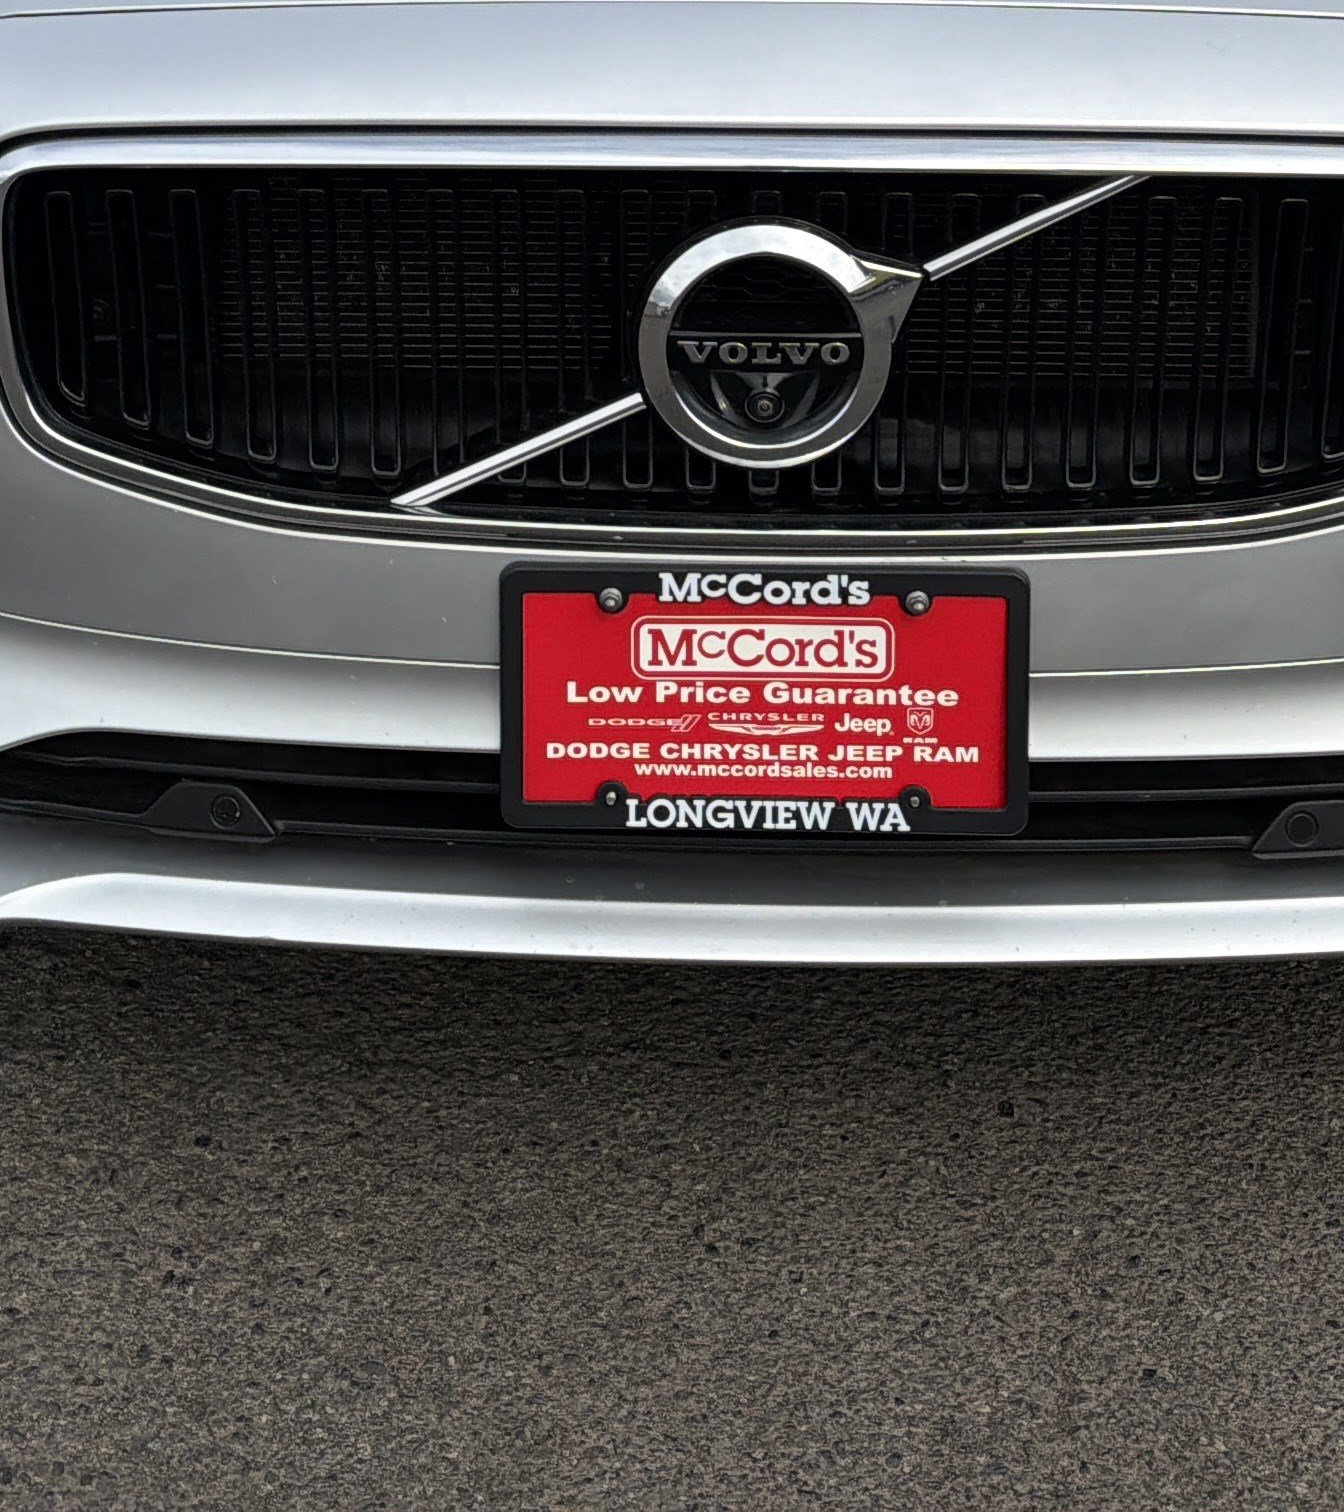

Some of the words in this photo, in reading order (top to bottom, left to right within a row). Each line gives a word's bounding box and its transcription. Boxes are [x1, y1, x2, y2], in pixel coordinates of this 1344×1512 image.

[677, 341, 850, 365] VOLVO
[658, 572, 871, 605] McCord's
[647, 628, 878, 668] McCord's
[566, 681, 643, 703] Low
[655, 681, 750, 704] Price
[763, 681, 960, 706] Guarantee
[708, 712, 825, 722] CHRYSLER
[834, 712, 892, 736] Jeep
[546, 742, 651, 759] DODGE
[659, 742, 819, 761] CHRYSLER
[827, 745, 903, 762] JEEP
[913, 746, 979, 763] RAM
[633, 762, 893, 779] www.mccordsales.com
[625, 798, 835, 831] LONGVIEW
[845, 802, 911, 832] WA
